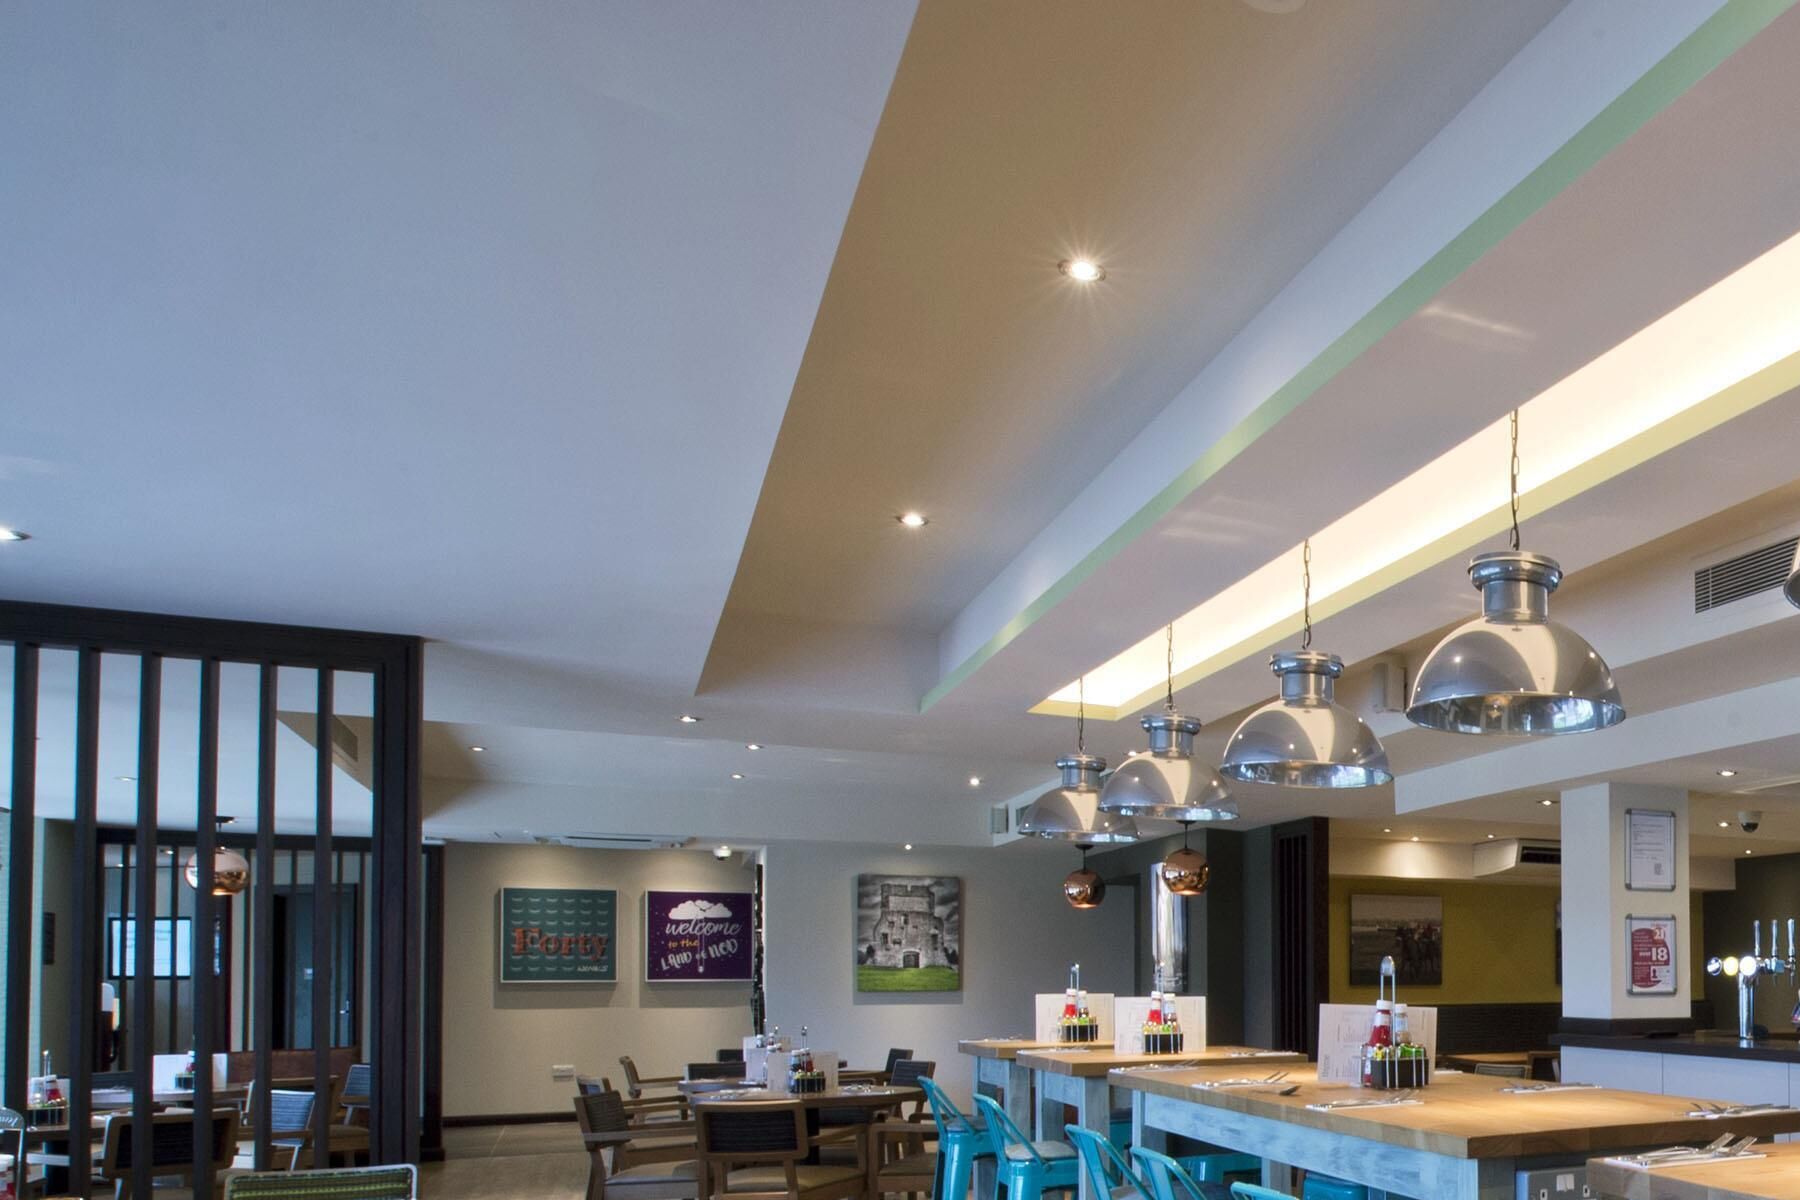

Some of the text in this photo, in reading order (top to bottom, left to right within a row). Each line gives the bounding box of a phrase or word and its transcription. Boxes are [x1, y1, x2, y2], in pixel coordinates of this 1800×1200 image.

[665, 918, 742, 936] welcome
[512, 927, 608, 961] Forty
[668, 938, 699, 949] to the
[1651, 947, 1668, 961] 18
